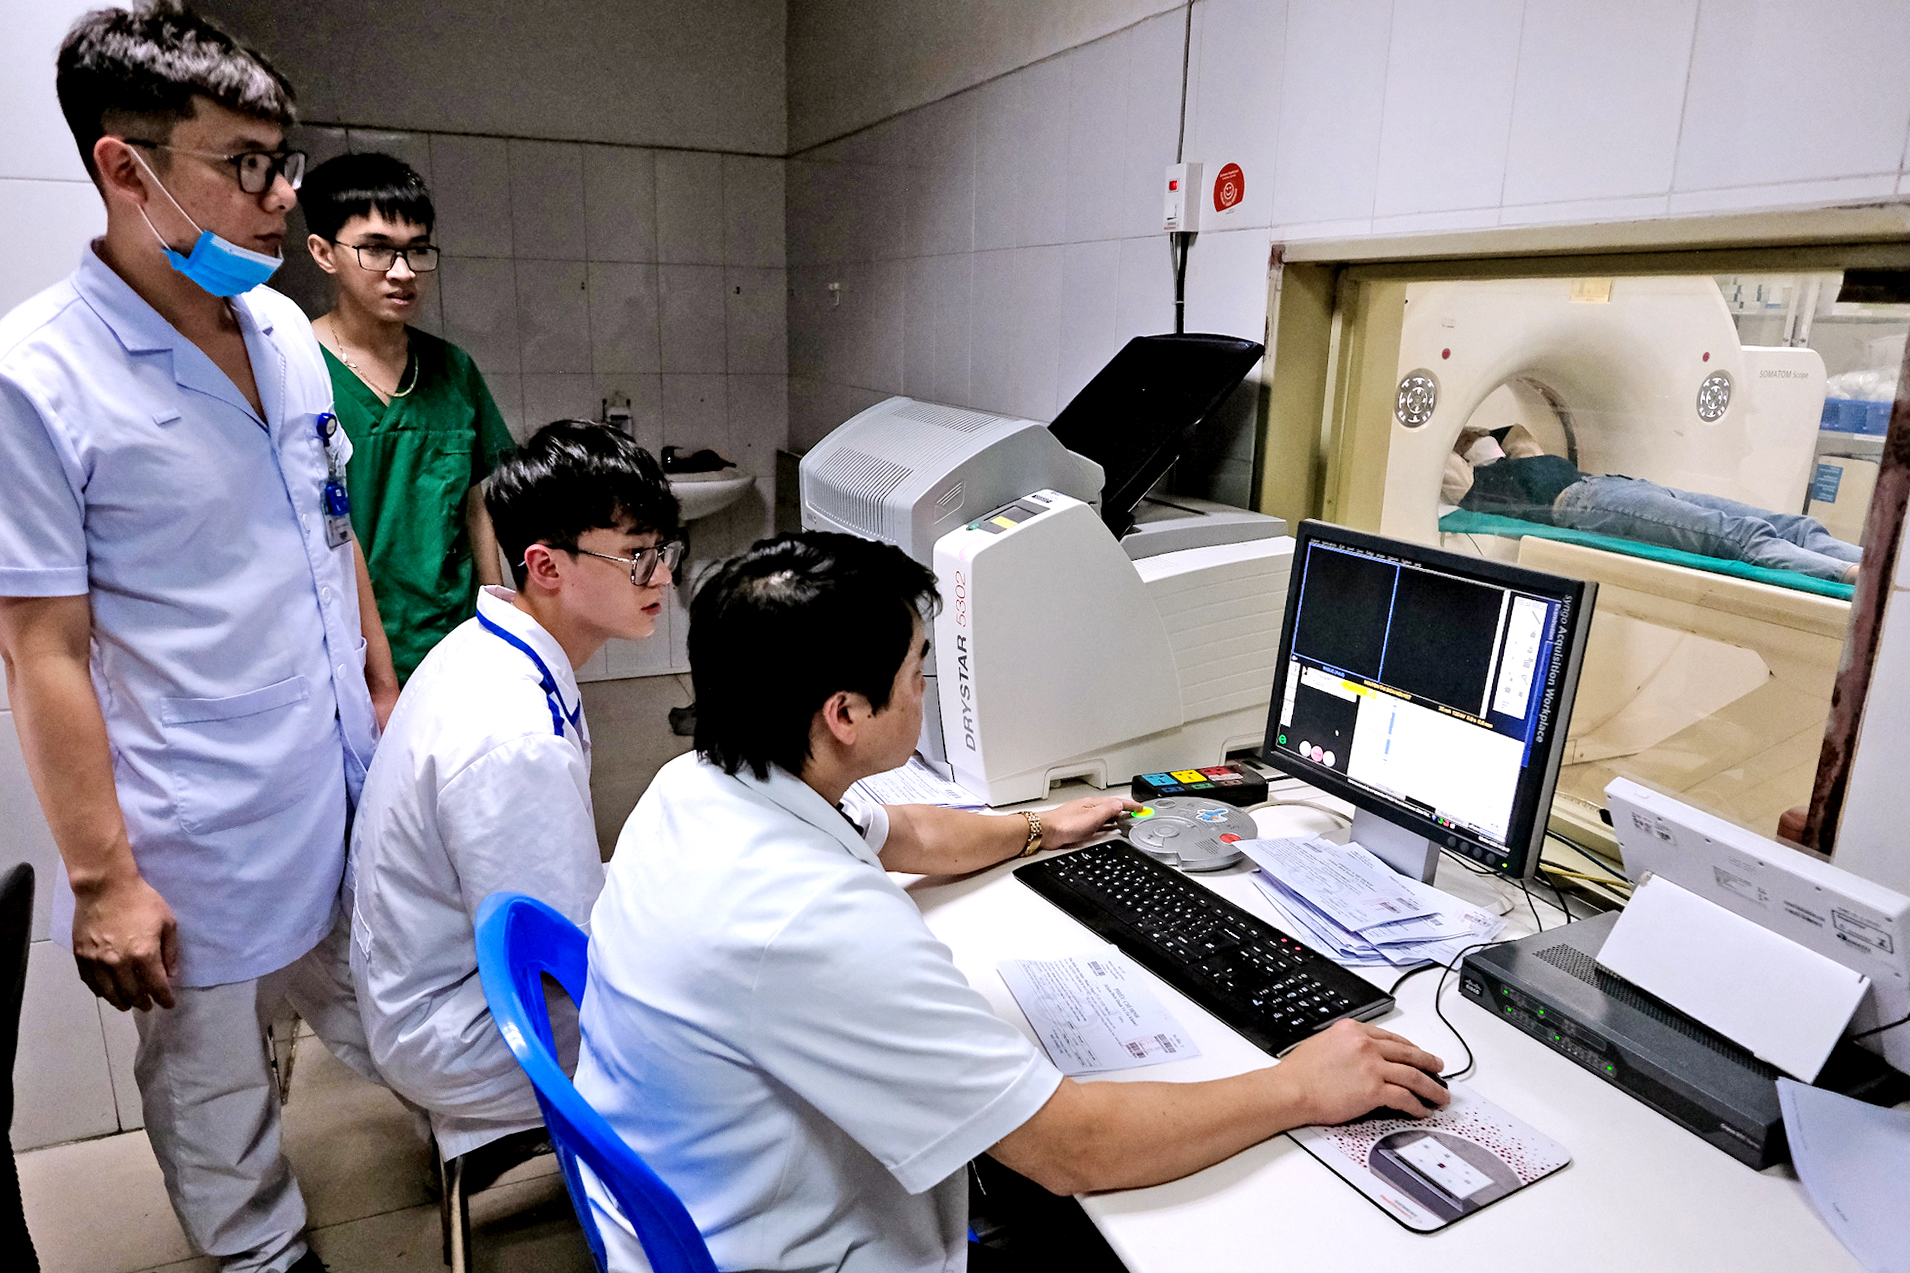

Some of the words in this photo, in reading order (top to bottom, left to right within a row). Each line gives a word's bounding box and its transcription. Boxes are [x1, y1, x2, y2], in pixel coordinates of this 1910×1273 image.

[1759, 370, 1791, 379] SOMATOM
[1793, 371, 1809, 380] Scope
[955, 571, 967, 627] 5302
[1548, 625, 1568, 686] Acquisition
[956, 634, 976, 752] DRYSTAR
[1536, 689, 1555, 743] Workplace
